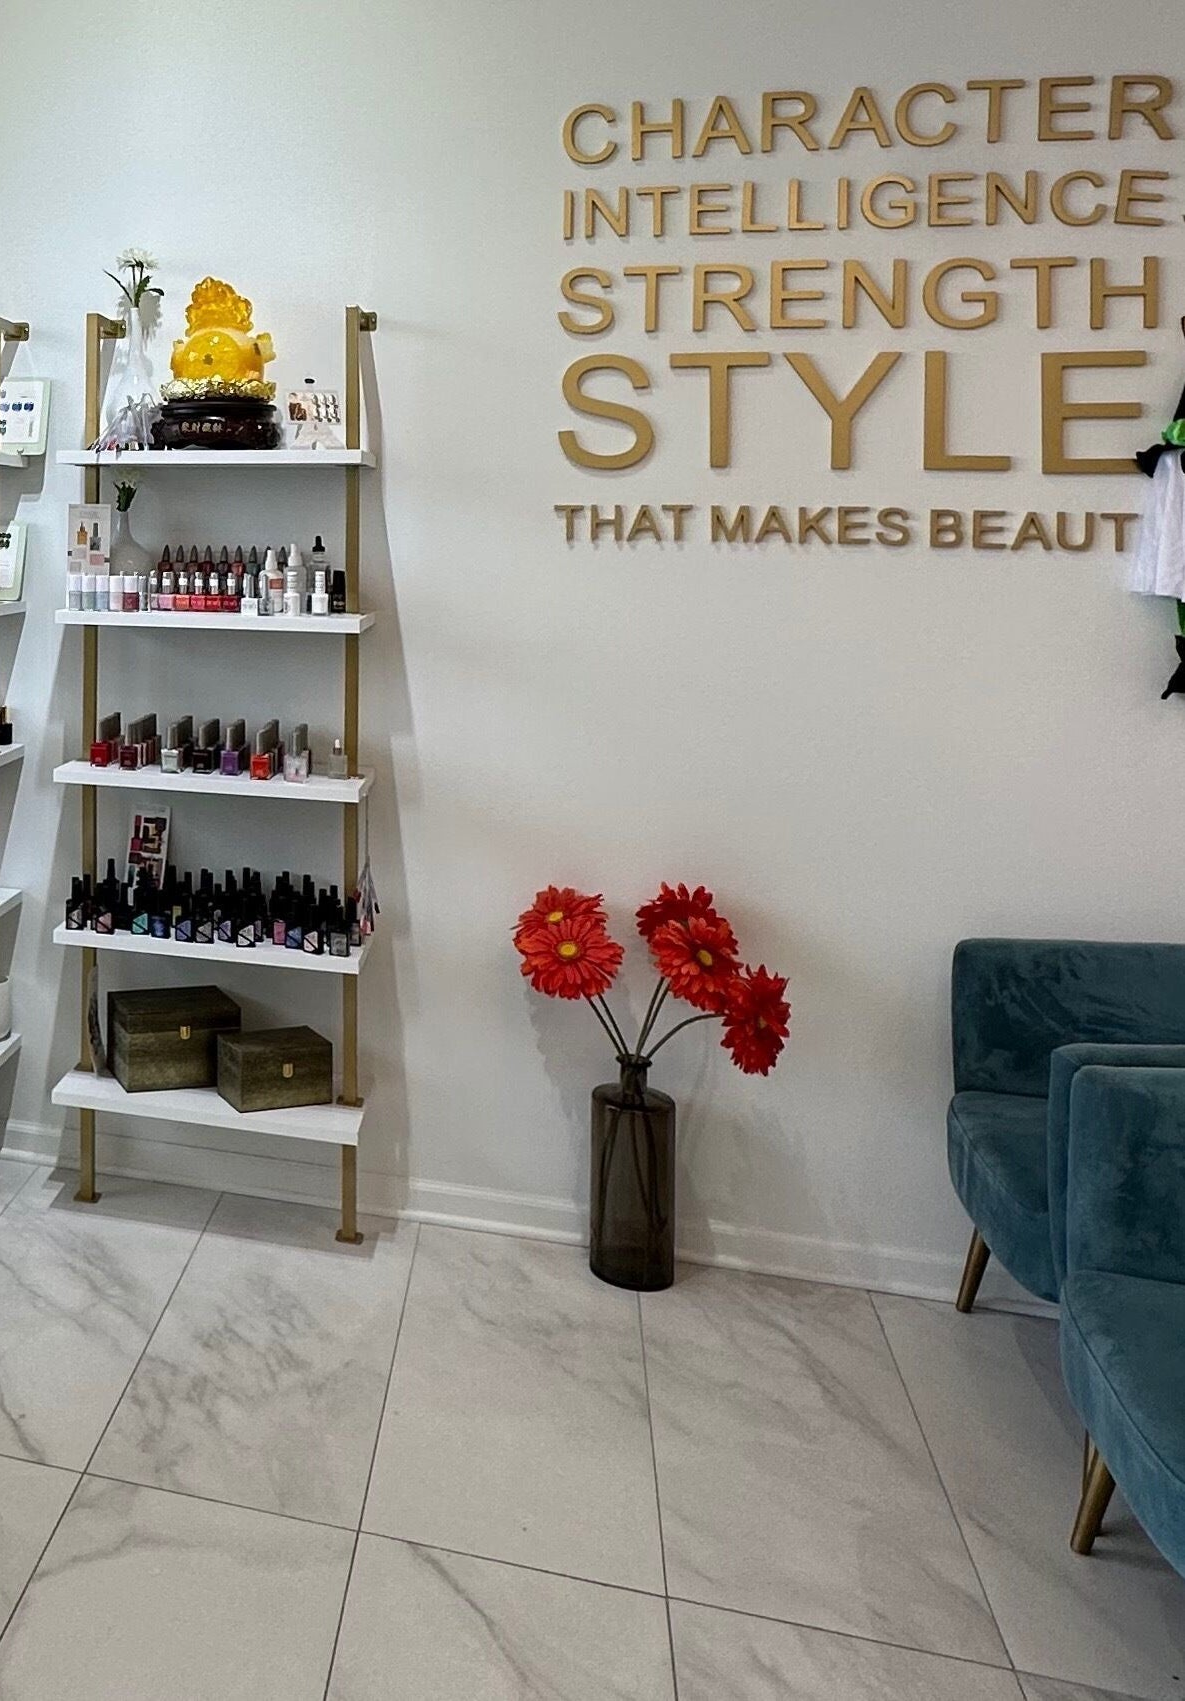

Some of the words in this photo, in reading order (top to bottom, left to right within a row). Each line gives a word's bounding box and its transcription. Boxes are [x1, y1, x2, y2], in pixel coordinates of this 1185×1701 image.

[562, 75, 1175, 165] CHARACTER
[563, 169, 1170, 241] INTELLIGENCE
[558, 256, 1160, 336] STRENGTH
[558, 350, 1148, 475] STYLE
[554, 505, 693, 543] THAT
[710, 505, 910, 546] MAKES
[929, 509, 1139, 552] BEAUT
